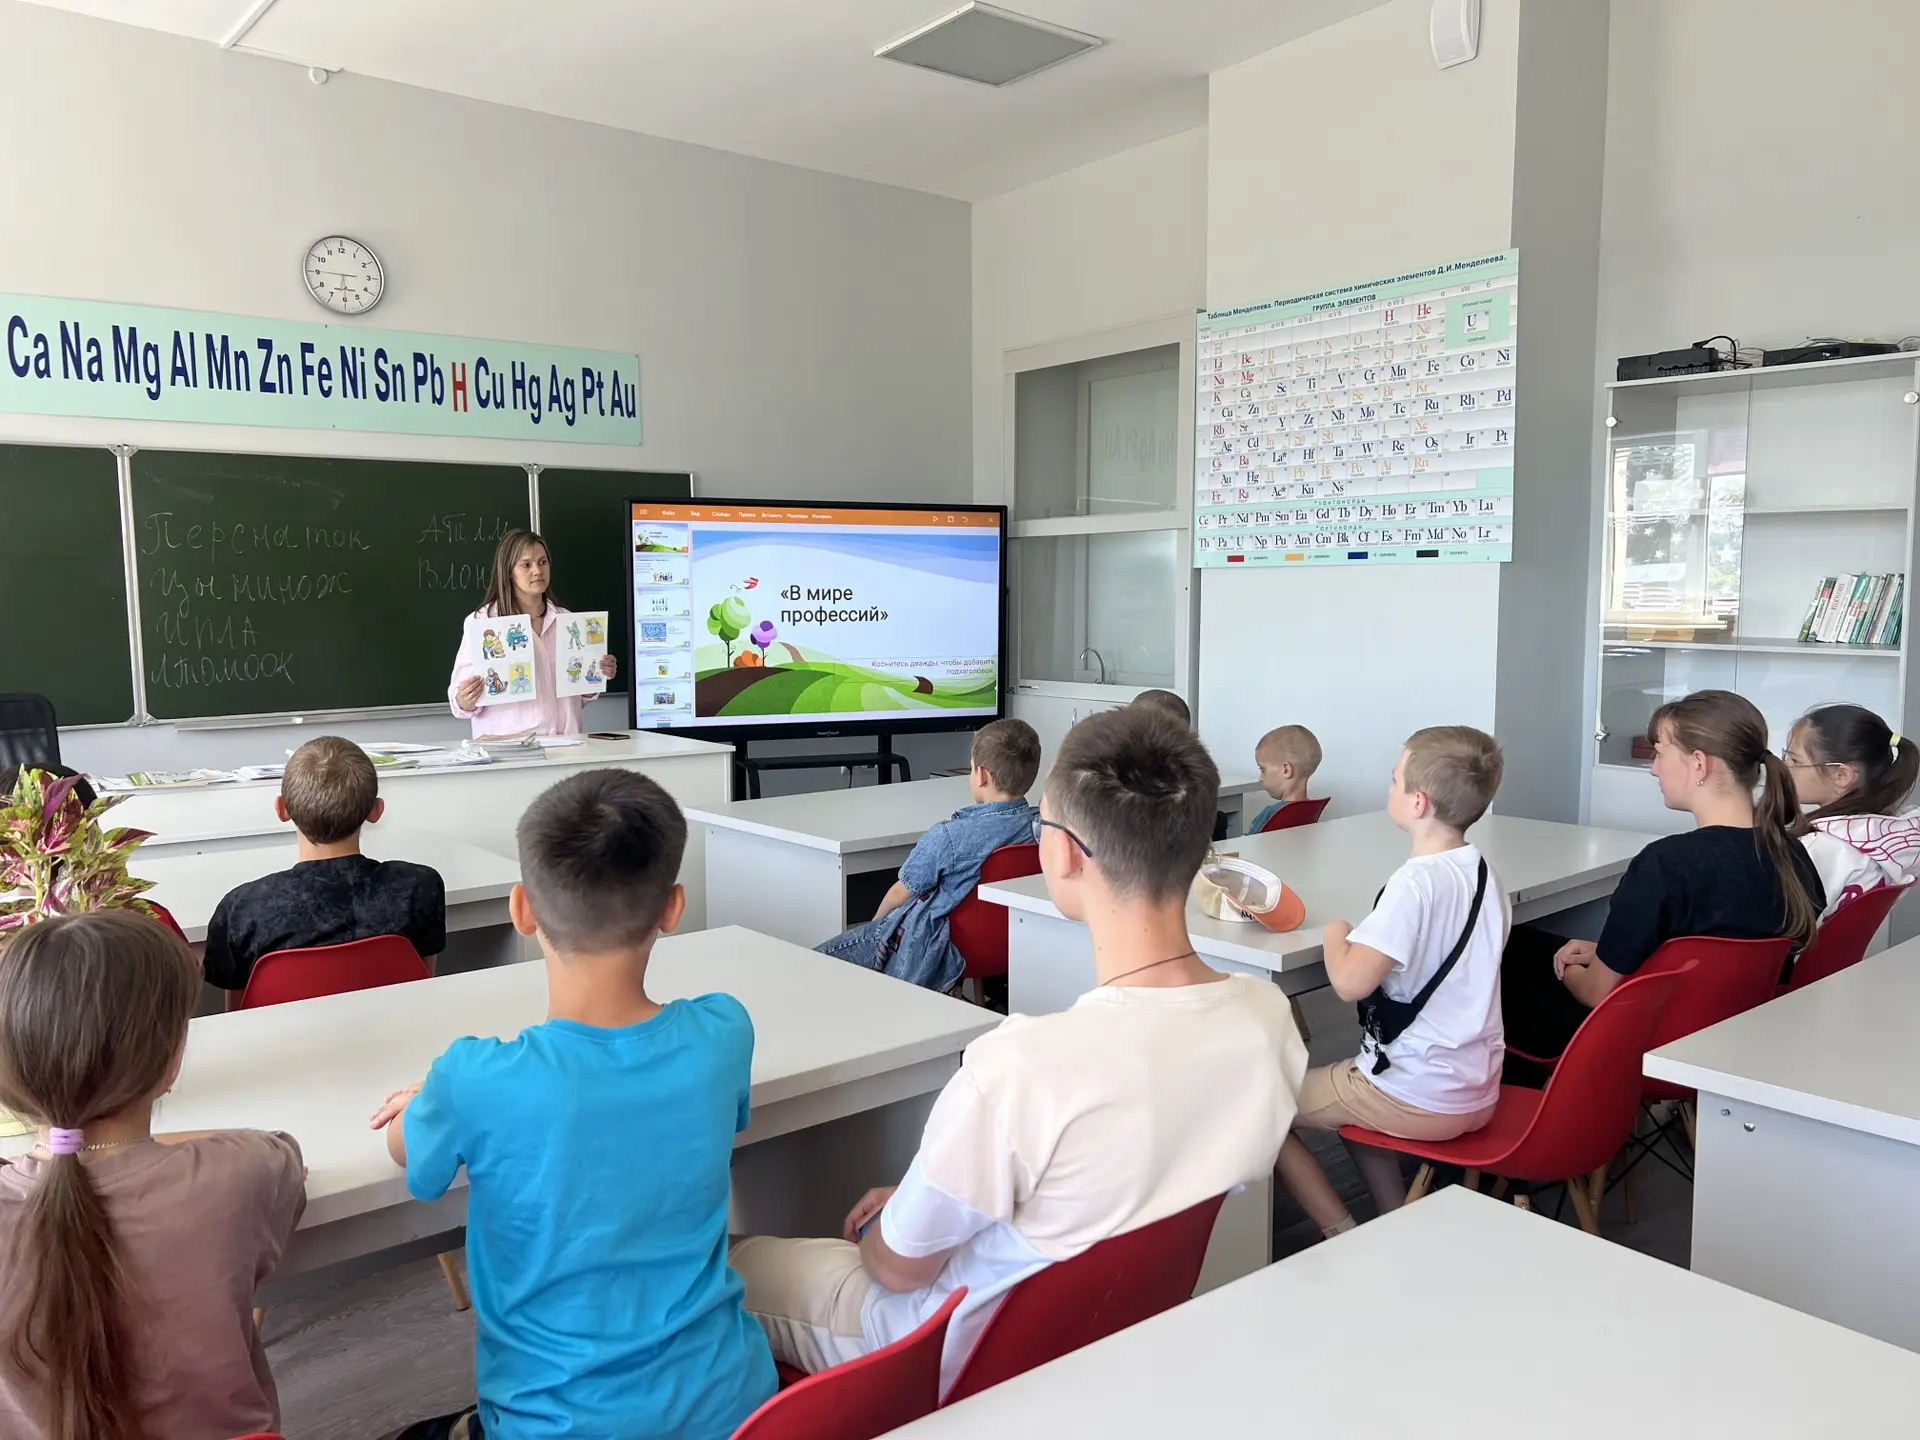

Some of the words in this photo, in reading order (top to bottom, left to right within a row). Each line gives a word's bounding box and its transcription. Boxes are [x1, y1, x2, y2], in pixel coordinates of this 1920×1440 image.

[1208, 310, 1232, 320] Таблица
[1274, 292, 1323, 307] Периодическая
[1325, 286, 1352, 298] система
[1354, 278, 1394, 292] химических
[1397, 270, 1436, 282] элементов
[1312, 303, 1335, 312] ГРУППА
[1338, 294, 1376, 308] ЭЛЕМЕНТОВ
[1385, 310, 1394, 321] H
[1418, 304, 1431, 315] He
[1467, 314, 1477, 327] U
[7, 315, 52, 379] Ca
[59, 320, 104, 381] Na
[112, 325, 161, 400] Mg
[170, 331, 198, 388] Al
[205, 333, 250, 391] Mn
[257, 338, 293, 394] Zn
[300, 342, 332, 398] Fe
[340, 346, 368, 400] Ni
[374, 348, 406, 402] Sn
[413, 352, 444, 406] Pb
[452, 362, 468, 412] H
[475, 356, 505, 409] Cu
[511, 360, 541, 424] Hg
[548, 364, 575, 426] Ag
[582, 367, 605, 416] Pt
[611, 370, 636, 418] Au
[1214, 359, 1222, 368] Li
[1214, 392, 1220, 402] K
[1241, 388, 1250, 398] Ca
[1277, 383, 1287, 393] Sc
[1307, 378, 1316, 389] Ti
[1338, 374, 1345, 384] V
[1364, 370, 1375, 380] Cr
[1390, 365, 1406, 377] Mn
[1428, 360, 1439, 372] Fe
[1460, 355, 1474, 367] Co
[1497, 350, 1509, 362] Ni
[1214, 376, 1224, 386] Na
[1241, 372, 1254, 384] Mg
[1213, 426, 1224, 435] Rb
[1240, 422, 1248, 432] Sr
[1278, 417, 1286, 427] Y
[1304, 414, 1314, 424] Zr
[1331, 410, 1345, 421] Nb
[1360, 408, 1375, 418] Mo
[1393, 403, 1406, 414] Tc
[1425, 399, 1438, 410] Ru
[1460, 395, 1475, 406] Rh
[1497, 389, 1511, 402] Pd
[1222, 408, 1233, 418] Cu
[1248, 404, 1259, 414] Zn
[1212, 458, 1222, 468] Cs
[1239, 455, 1249, 465] Ba
[1303, 449, 1316, 460] Hf
[1333, 446, 1344, 456] Ta
[1363, 443, 1374, 454] W
[1392, 440, 1404, 451] Re
[1425, 437, 1438, 448] Os
[1466, 433, 1474, 444] Ir
[1496, 430, 1507, 442] Pt
[1221, 442, 1232, 452] Ag
[1248, 438, 1259, 448] Cd
[1221, 474, 1231, 484] Au
[1247, 472, 1259, 482] Hg
[1212, 491, 1220, 500] Fr
[1239, 489, 1249, 498] Ra
[1302, 484, 1314, 494] Ku
[1332, 482, 1344, 492] Ns
[1218, 514, 1227, 524] Pr
[1236, 514, 1249, 523] Nd
[1255, 512, 1270, 522] Pm
[1275, 511, 1289, 521] Sm
[1296, 510, 1307, 520] Eu
[1316, 509, 1330, 519] Gd
[1338, 508, 1350, 518] Tb
[1360, 506, 1373, 517] Dy
[1382, 505, 1396, 515] Ho
[1405, 504, 1416, 514] Er
[1427, 502, 1444, 513] Tm
[1452, 500, 1468, 512] Yb
[1479, 499, 1493, 510] Lu
[1199, 539, 1209, 548] Th
[1218, 538, 1227, 547] Pa
[1236, 537, 1244, 546] U
[1255, 536, 1267, 548] Np
[1275, 535, 1286, 545] Pu
[1295, 534, 1310, 544] Am
[1316, 533, 1332, 543] Cm
[1337, 532, 1349, 542] Bk
[1358, 531, 1370, 542] Cf
[1382, 531, 1392, 541] Es
[1405, 530, 1421, 540] Fm
[1427, 529, 1444, 539] Md
[1452, 528, 1466, 539] No
[1478, 527, 1491, 538] Lr
[781, 585, 801, 600] «В
[807, 588, 853, 604] мире
[781, 606, 888, 626] профессий»
